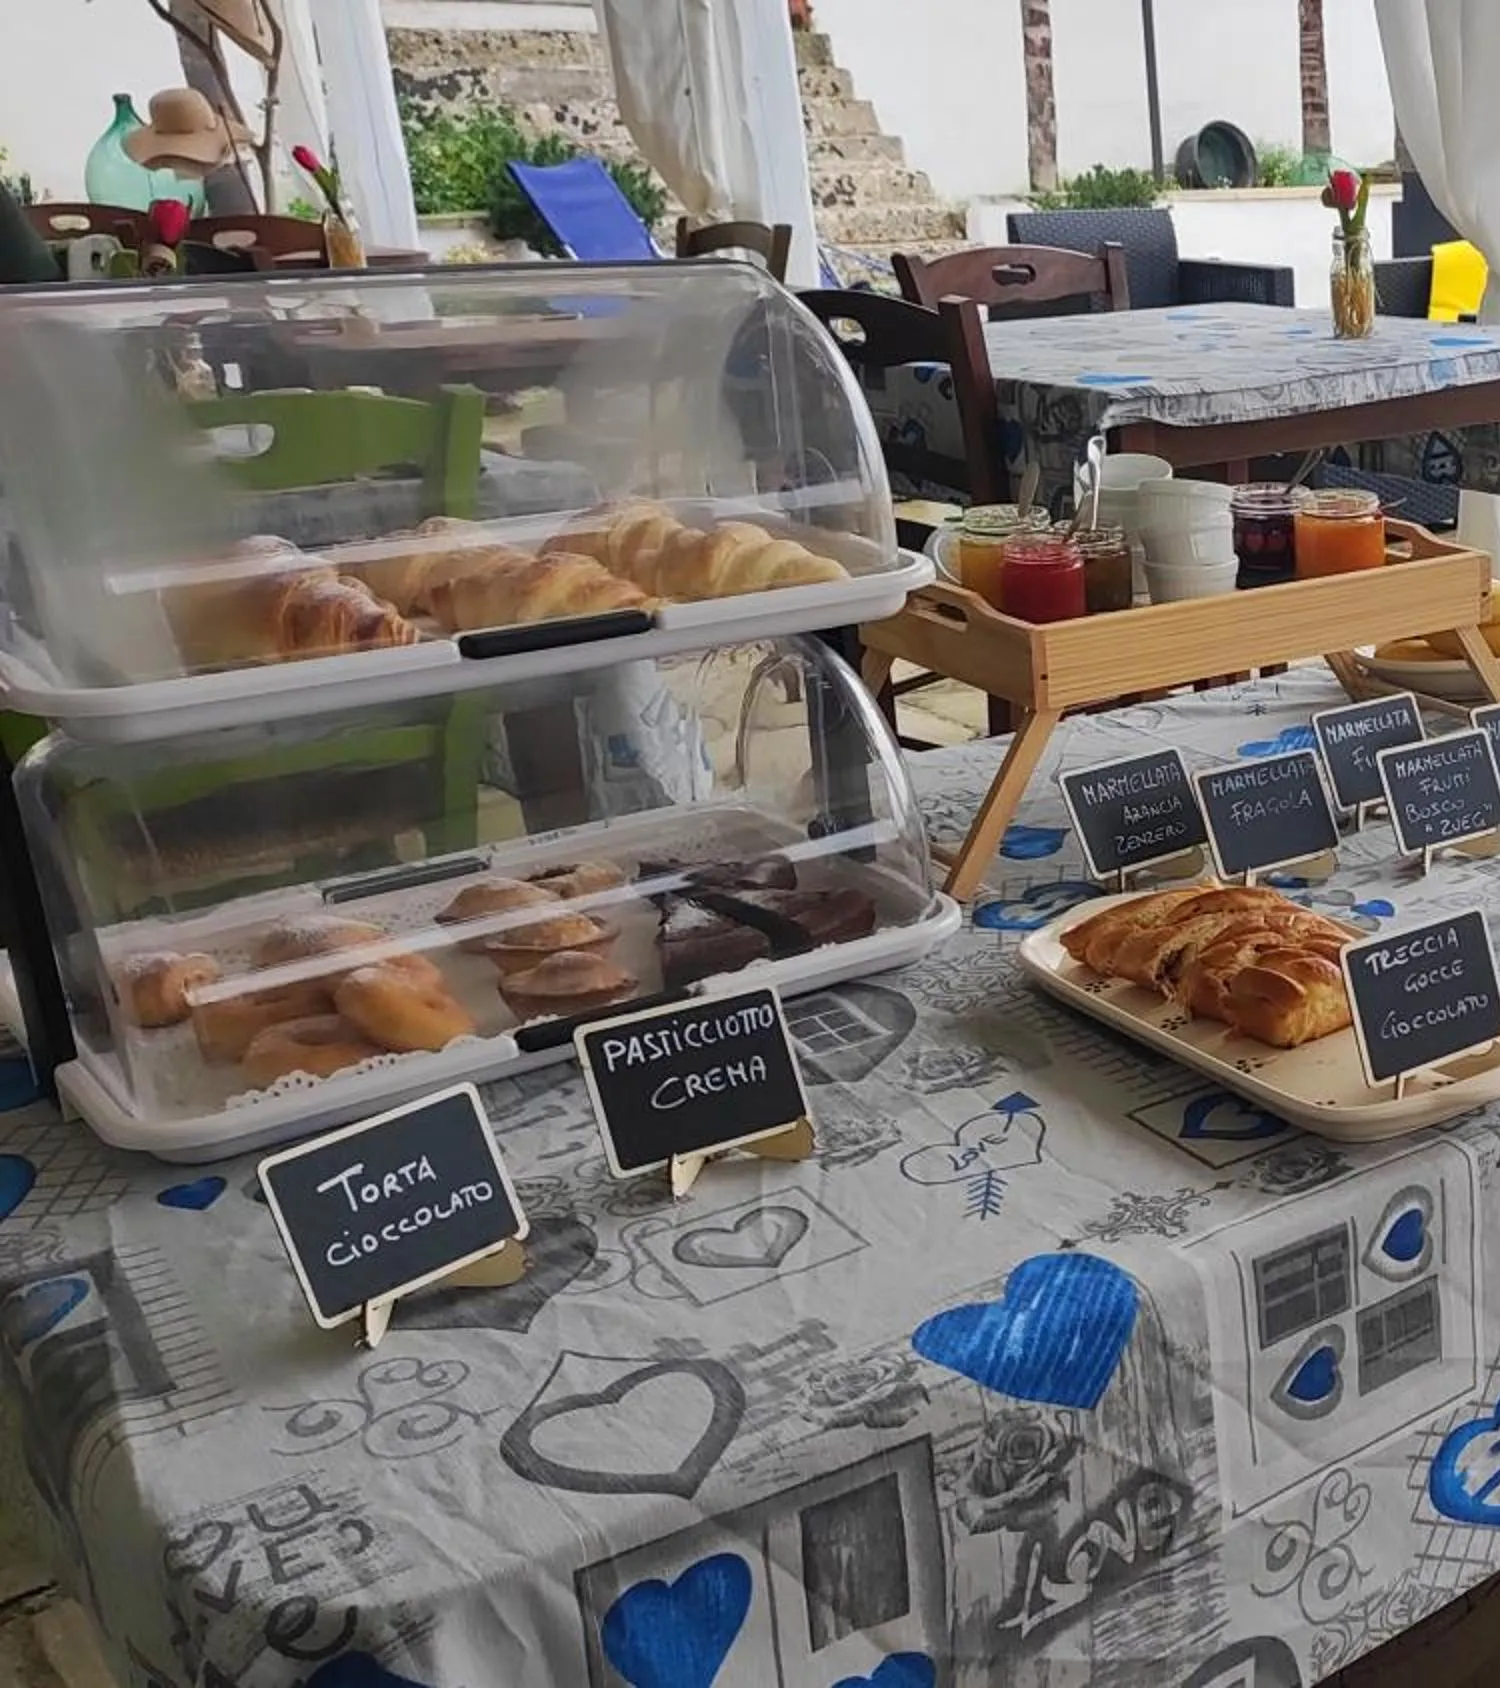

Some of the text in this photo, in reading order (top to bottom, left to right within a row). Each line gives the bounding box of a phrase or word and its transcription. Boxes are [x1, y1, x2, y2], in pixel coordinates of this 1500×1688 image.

[1325, 708, 1412, 745] MARMELLATA
[1395, 740, 1483, 778] MARMELLATA
[1081, 761, 1181, 806] MARMELLATA
[1230, 788, 1313, 826] FRAGOLA
[1365, 927, 1459, 976] TRECCIA
[1404, 959, 1464, 993] GOCCE
[603, 1003, 775, 1073] PASTICCIOTTO
[651, 1055, 767, 1110] CREMA
[317, 1155, 437, 1212] TORTA
